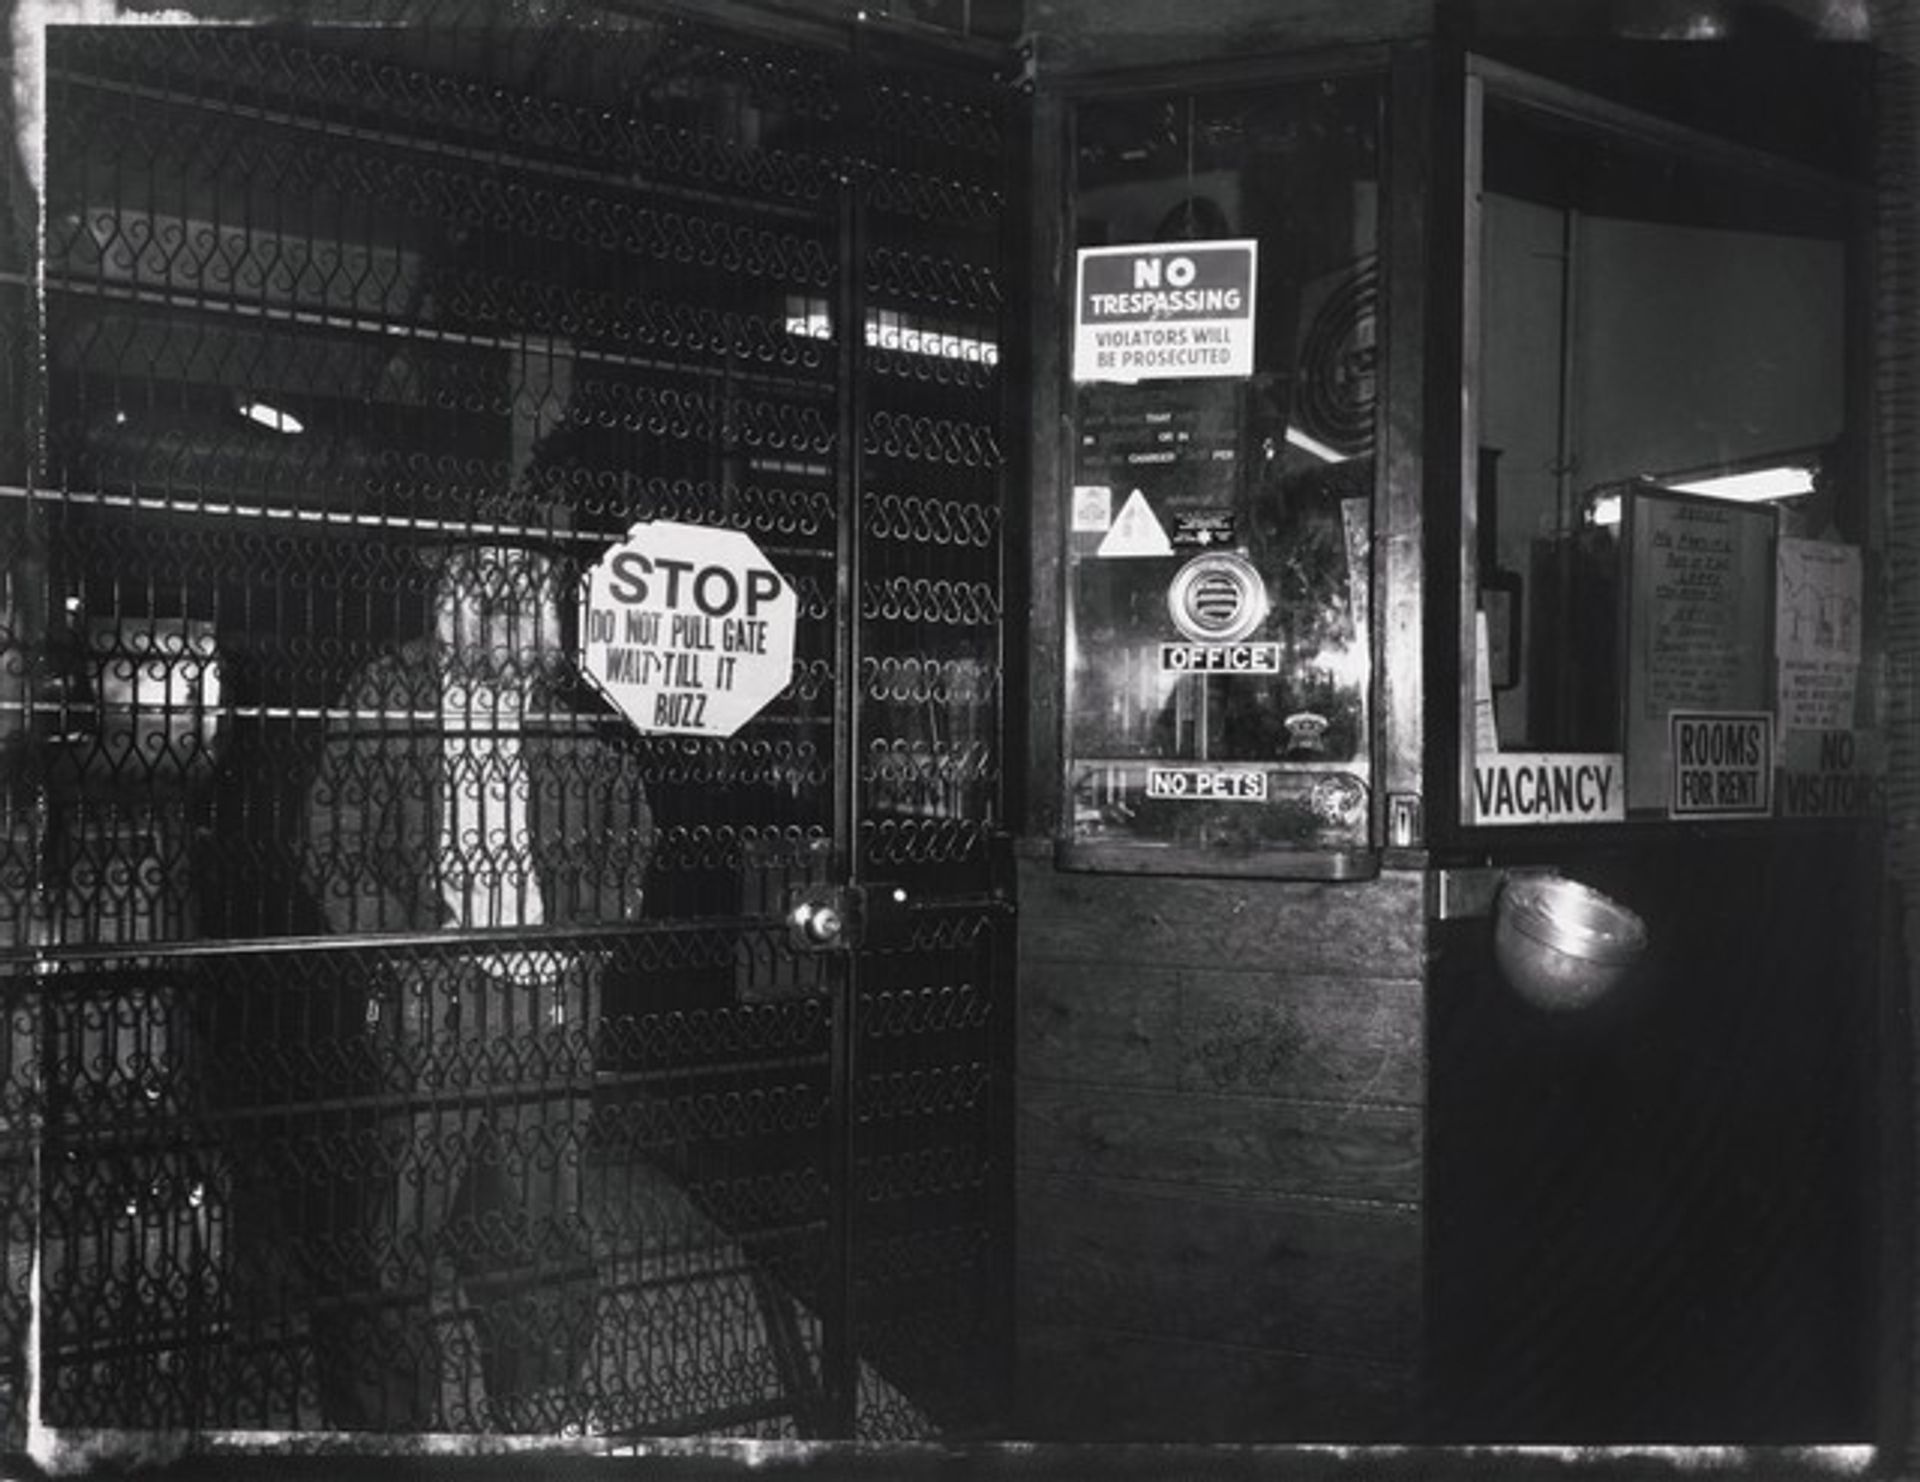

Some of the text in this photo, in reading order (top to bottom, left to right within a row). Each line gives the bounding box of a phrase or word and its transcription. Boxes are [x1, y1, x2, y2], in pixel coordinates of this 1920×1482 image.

[1134, 257, 1196, 289] NO
[1089, 289, 1241, 315] TRESPASSING
[1095, 326, 1231, 348] VIOLATORS WILL
[1097, 348, 1231, 368] BE PROSECUTED
[609, 551, 782, 618] STOP
[590, 609, 768, 654] DO NOT PULL GATE
[606, 648, 653, 686] WAIT
[716, 657, 737, 691] IT
[1169, 647, 1268, 669] OFFICE
[654, 693, 707, 728] BUZZ
[1681, 724, 1760, 767] ROOMS
[1821, 731, 1855, 771] NO
[1154, 773, 1260, 795] NO PETS
[1475, 766, 1612, 816] VACANCY
[1681, 770, 1760, 806] FOR RENT
